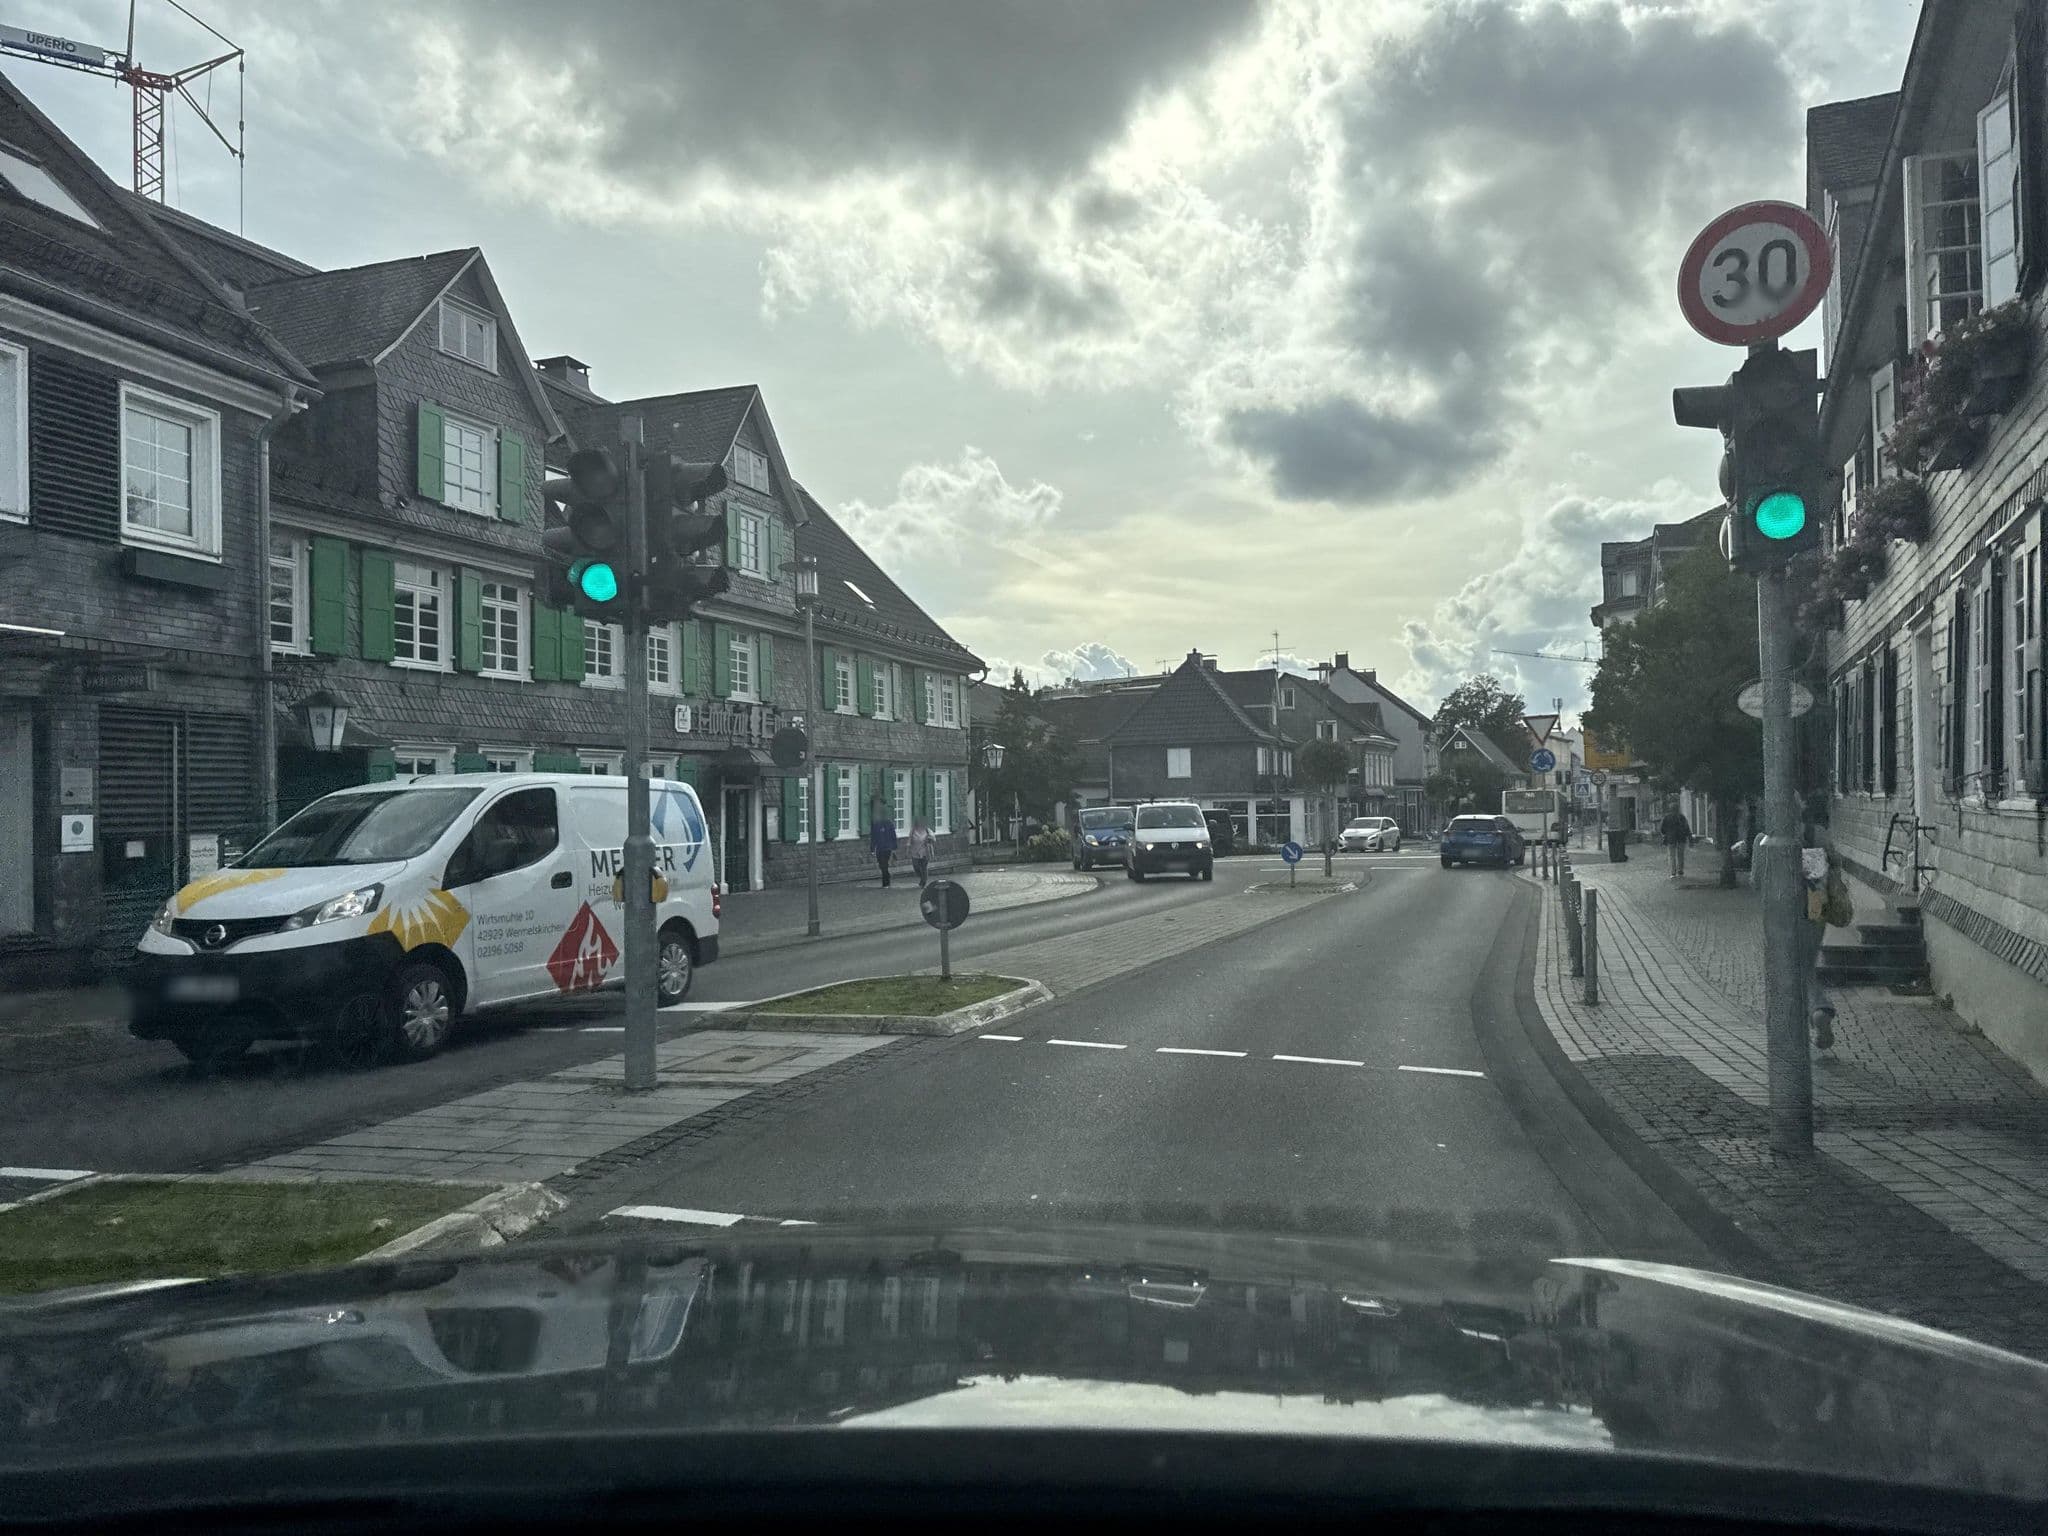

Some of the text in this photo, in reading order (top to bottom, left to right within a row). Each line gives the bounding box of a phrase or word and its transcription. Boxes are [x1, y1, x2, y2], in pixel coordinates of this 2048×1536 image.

[26, 32, 77, 53] UPERIO
[1712, 239, 1797, 308] 30
[525, 909, 535, 921] 10
[477, 928, 504, 941] 42929
[477, 944, 503, 958] 02196
